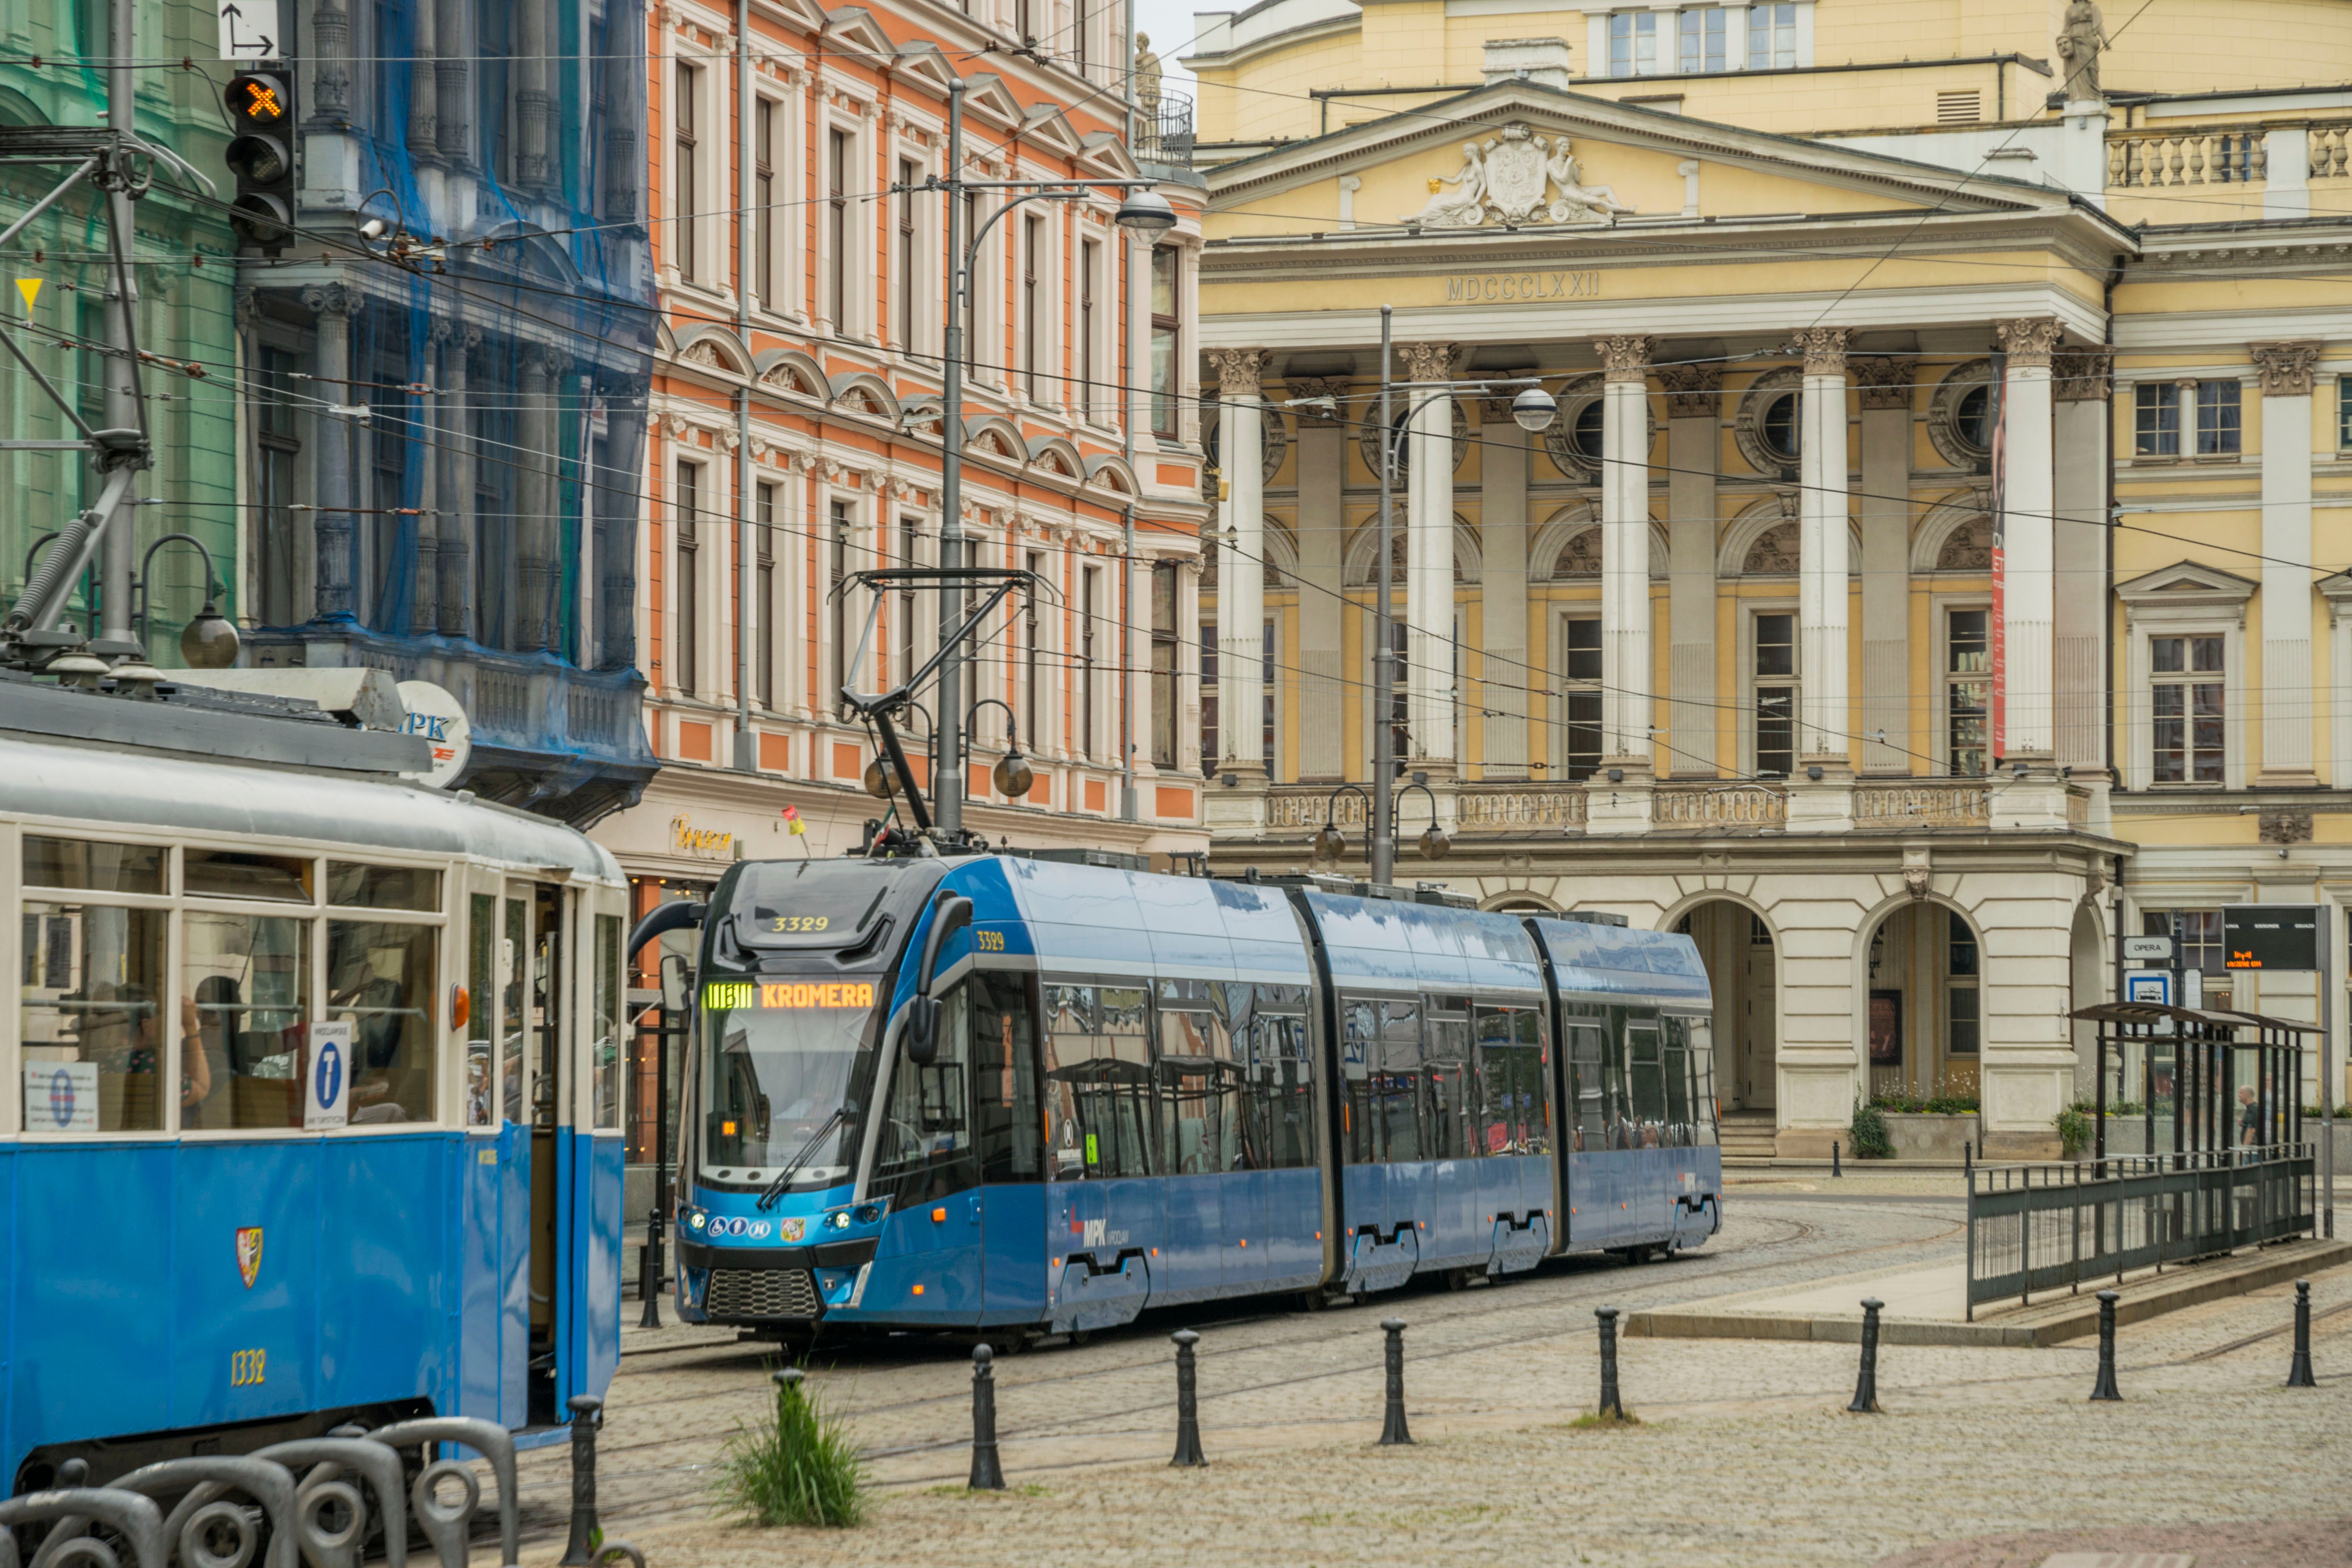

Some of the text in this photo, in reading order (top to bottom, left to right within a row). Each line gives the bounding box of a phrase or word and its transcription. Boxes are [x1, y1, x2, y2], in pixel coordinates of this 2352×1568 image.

[1446, 272, 1599, 300] MDCCCLXXII
[397, 712, 449, 742] PK
[772, 916, 829, 932] 3329
[976, 931, 1005, 951] 3329
[762, 984, 873, 1008] KROMERA
[1083, 1219, 1106, 1248] MPK
[231, 1348, 266, 1387] 1332
